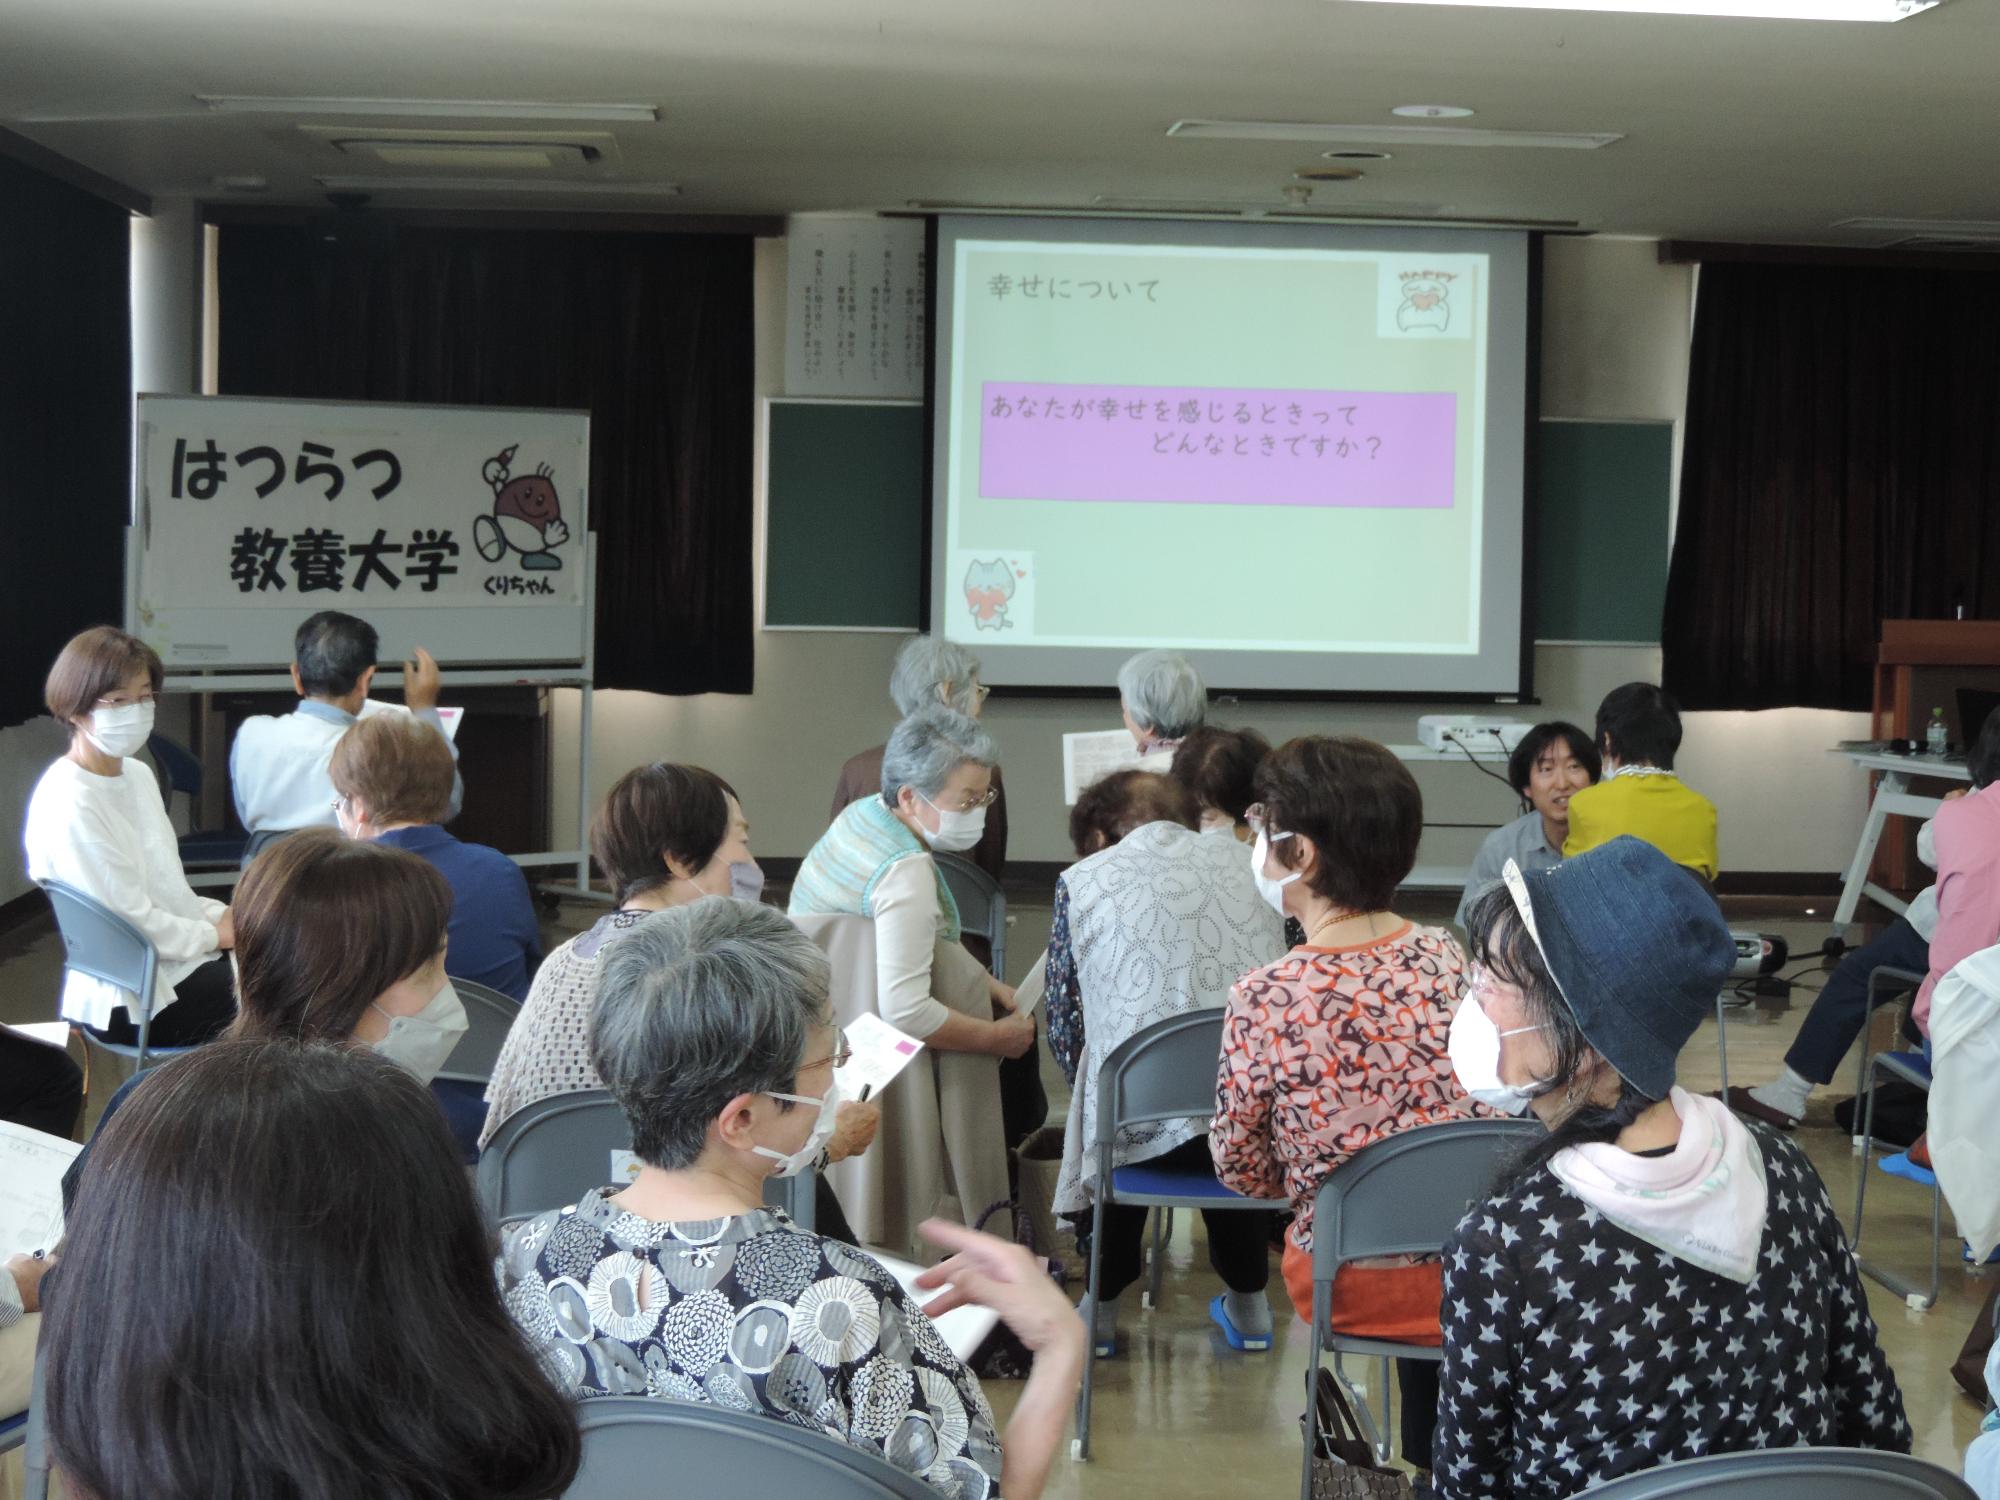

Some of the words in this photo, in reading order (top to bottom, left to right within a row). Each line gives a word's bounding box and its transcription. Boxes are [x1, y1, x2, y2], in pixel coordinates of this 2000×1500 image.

[986, 272, 1160, 303] 幸せについて
[990, 394, 1360, 426] あなたが幸せを感じるときって
[1151, 431, 1384, 461] どんなときですか？
[170, 437, 403, 502] はつらつ
[229, 526, 460, 593] 教養大学
[483, 575, 556, 596] くりちゃん
